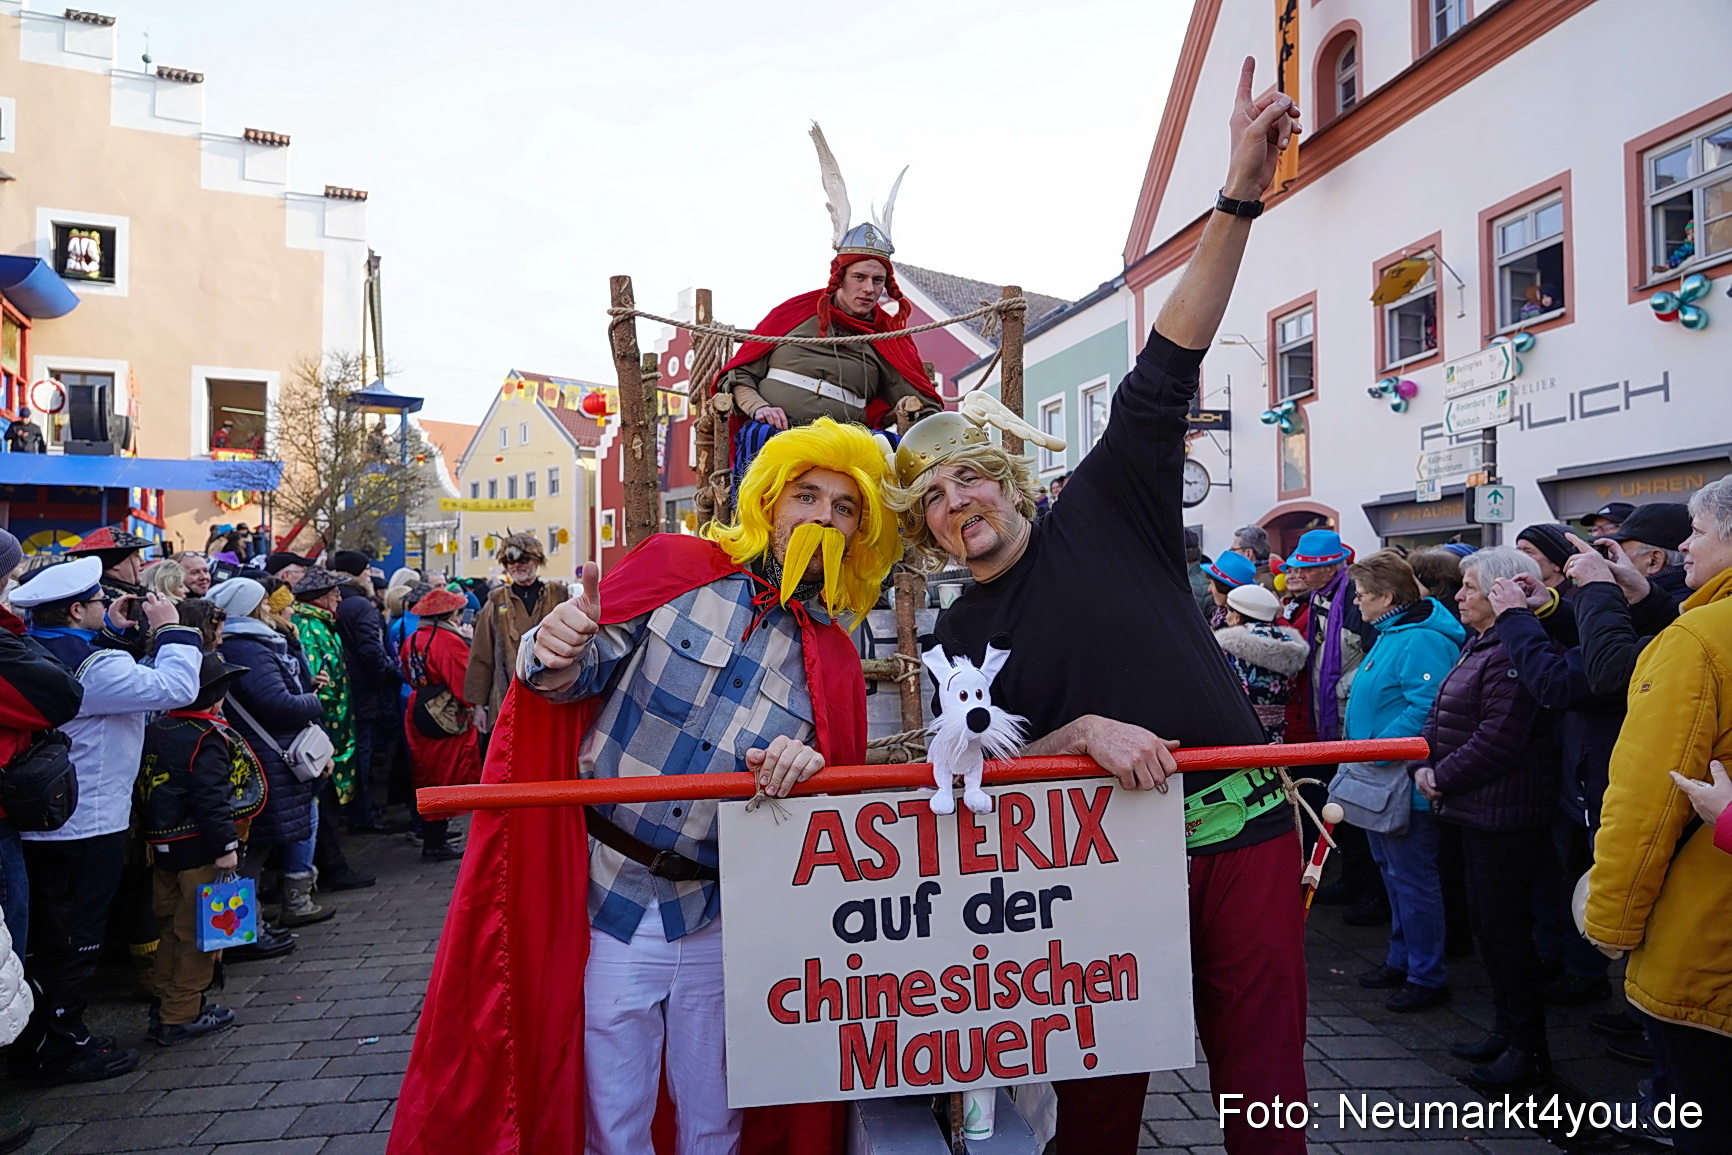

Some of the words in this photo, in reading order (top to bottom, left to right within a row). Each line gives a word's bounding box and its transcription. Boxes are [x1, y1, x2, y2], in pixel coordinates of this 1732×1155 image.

[1402, 503, 1465, 520] TRAURIN
[1620, 474, 1705, 497] UHREN
[792, 786, 1119, 886] ASTERIX
[832, 880, 942, 944] auf
[962, 876, 1073, 935] der
[767, 939, 1139, 1024] chinesischen
[839, 1005, 1099, 1092] Mauer!
